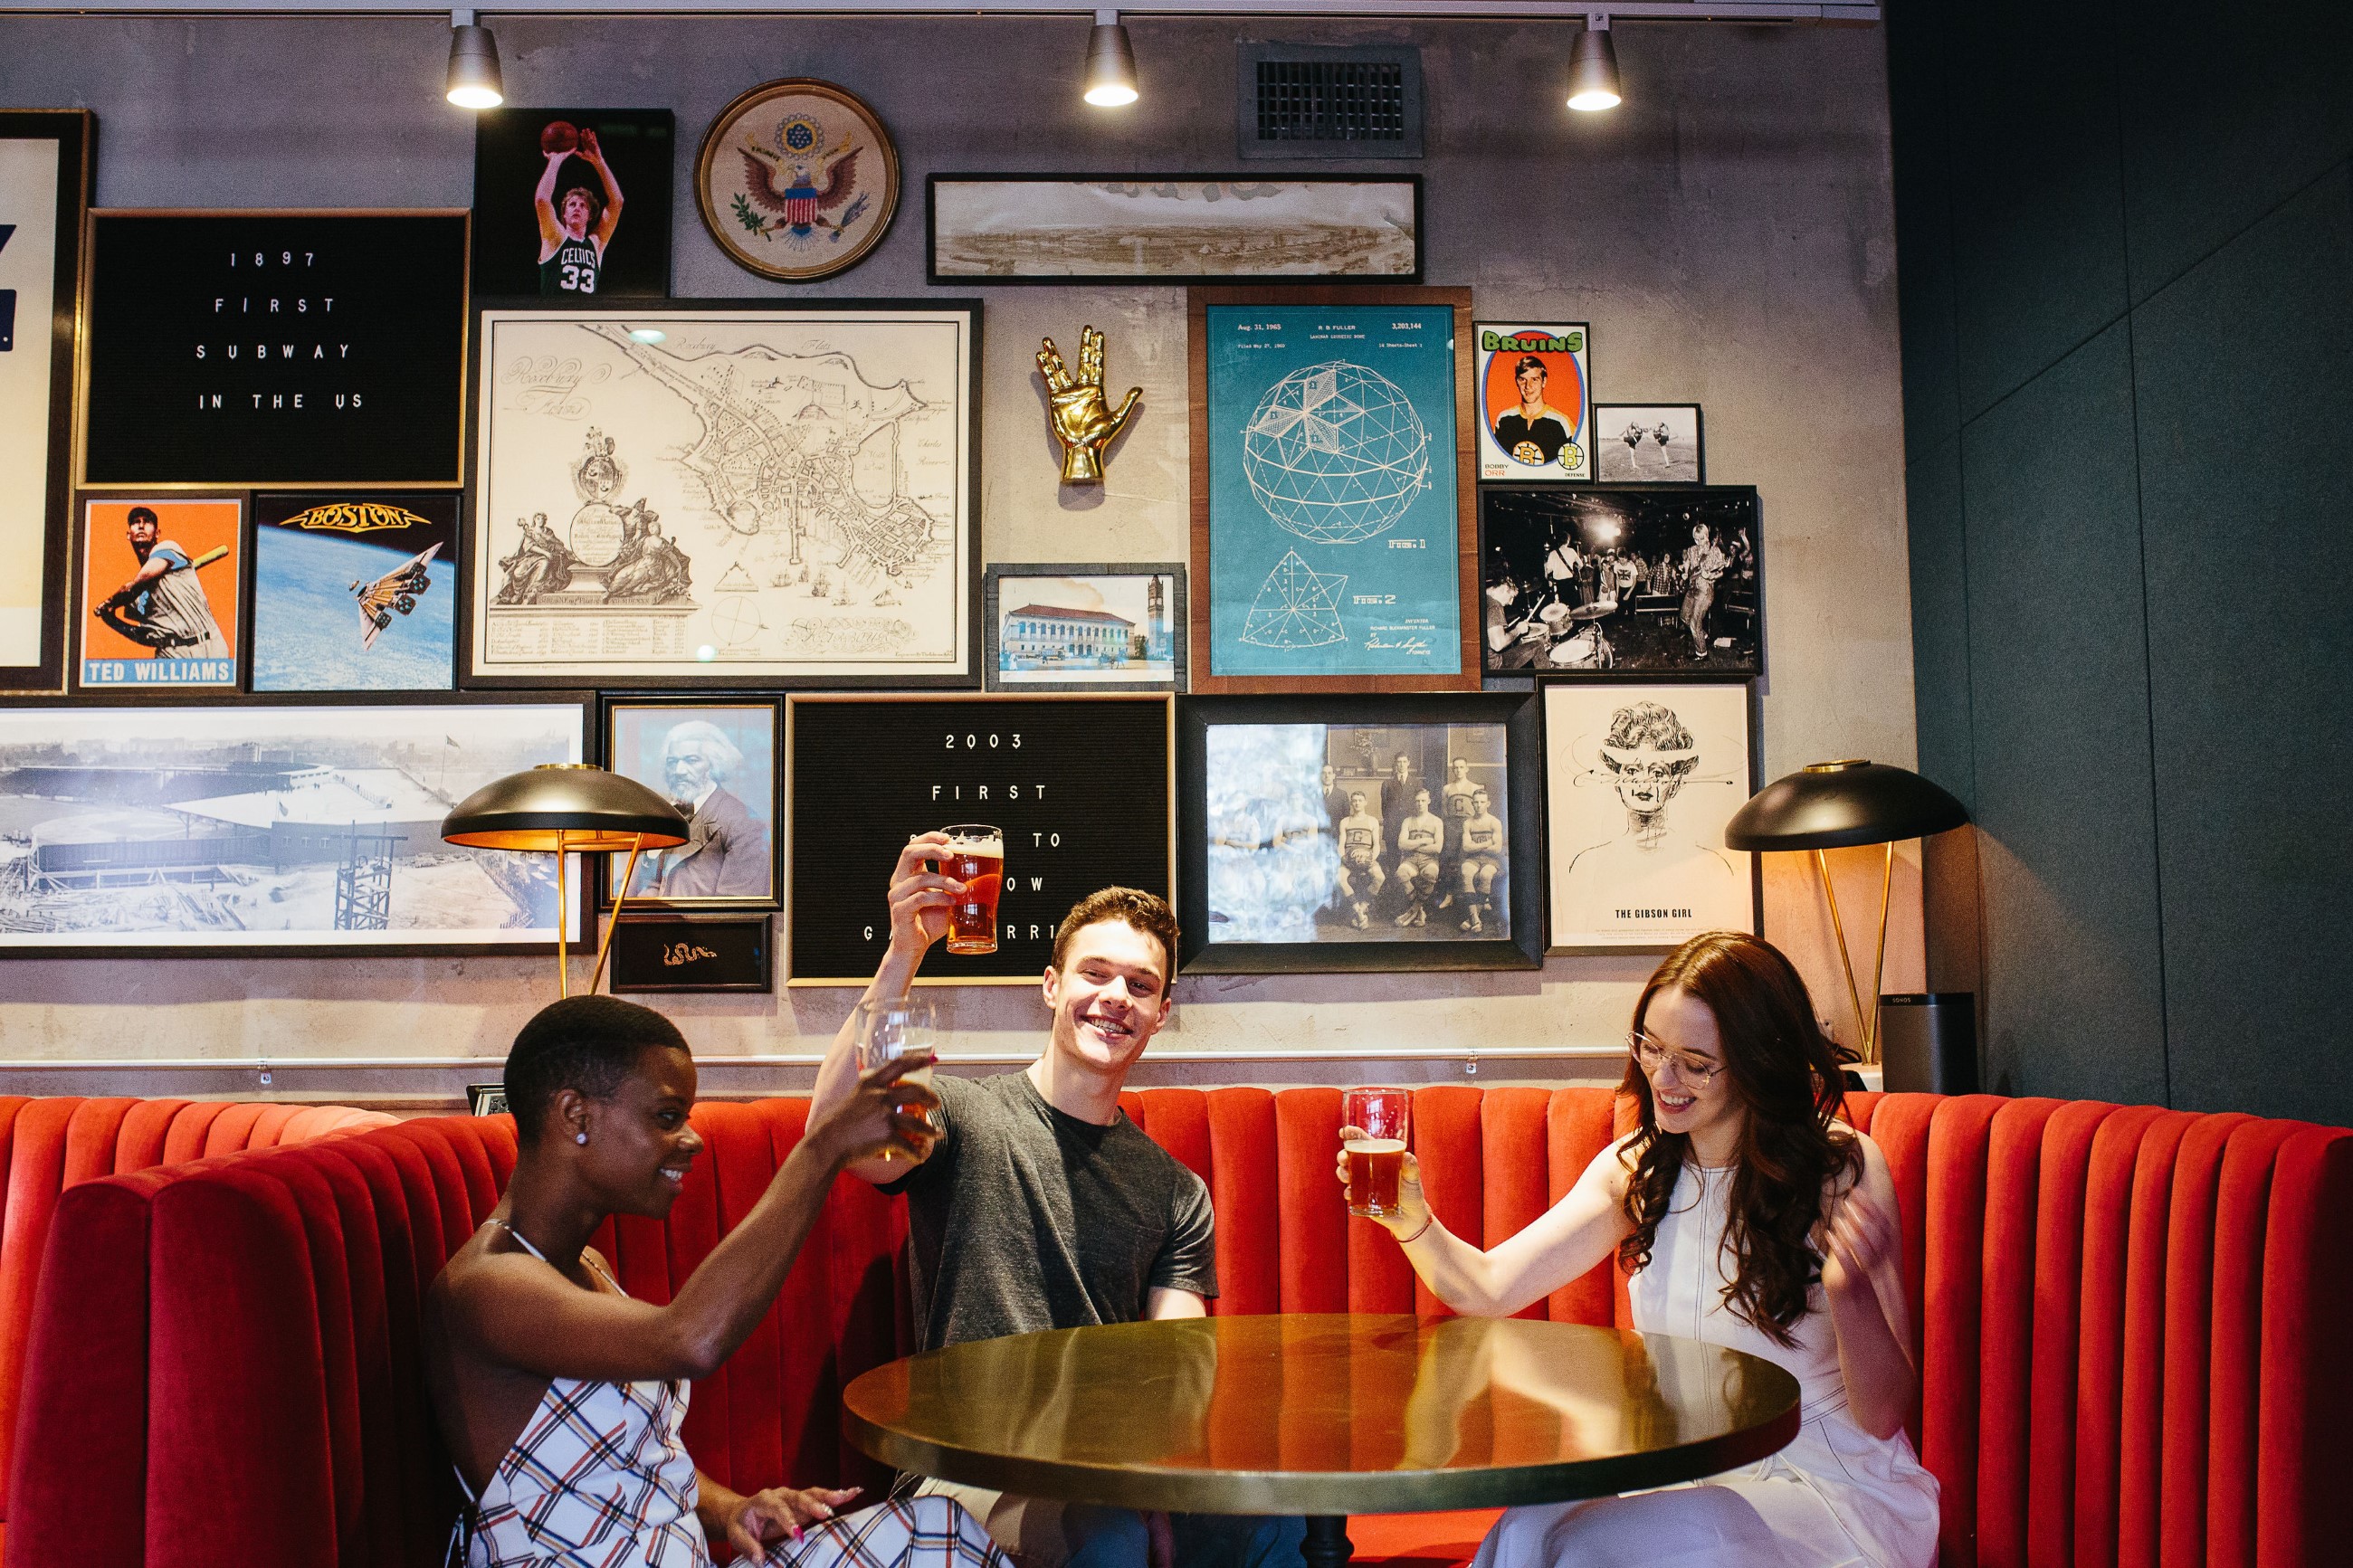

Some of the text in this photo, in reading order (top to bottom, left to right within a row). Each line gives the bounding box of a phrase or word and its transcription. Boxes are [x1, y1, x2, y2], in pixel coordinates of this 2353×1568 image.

[231, 252, 314, 267] 1897
[561, 247, 595, 269] CELTICS
[560, 264, 595, 294] 33
[215, 298, 334, 313] FIRST
[1392, 322, 1422, 330] 3,203,144
[1482, 330, 1583, 352] BRUINS
[195, 344, 349, 359] SUBWAY
[200, 394, 362, 410] IN THE US
[306, 503, 406, 529] BOSTON
[1419, 539, 1426, 549] 1
[1385, 594, 1396, 604] 2
[89, 661, 230, 681] TED WILLIAMS
[946, 734, 1022, 749] 2003
[932, 784, 1045, 801] FIRST
[1033, 832, 1060, 848] TO
[1615, 908, 1692, 918] THE GIBSON GIRL
